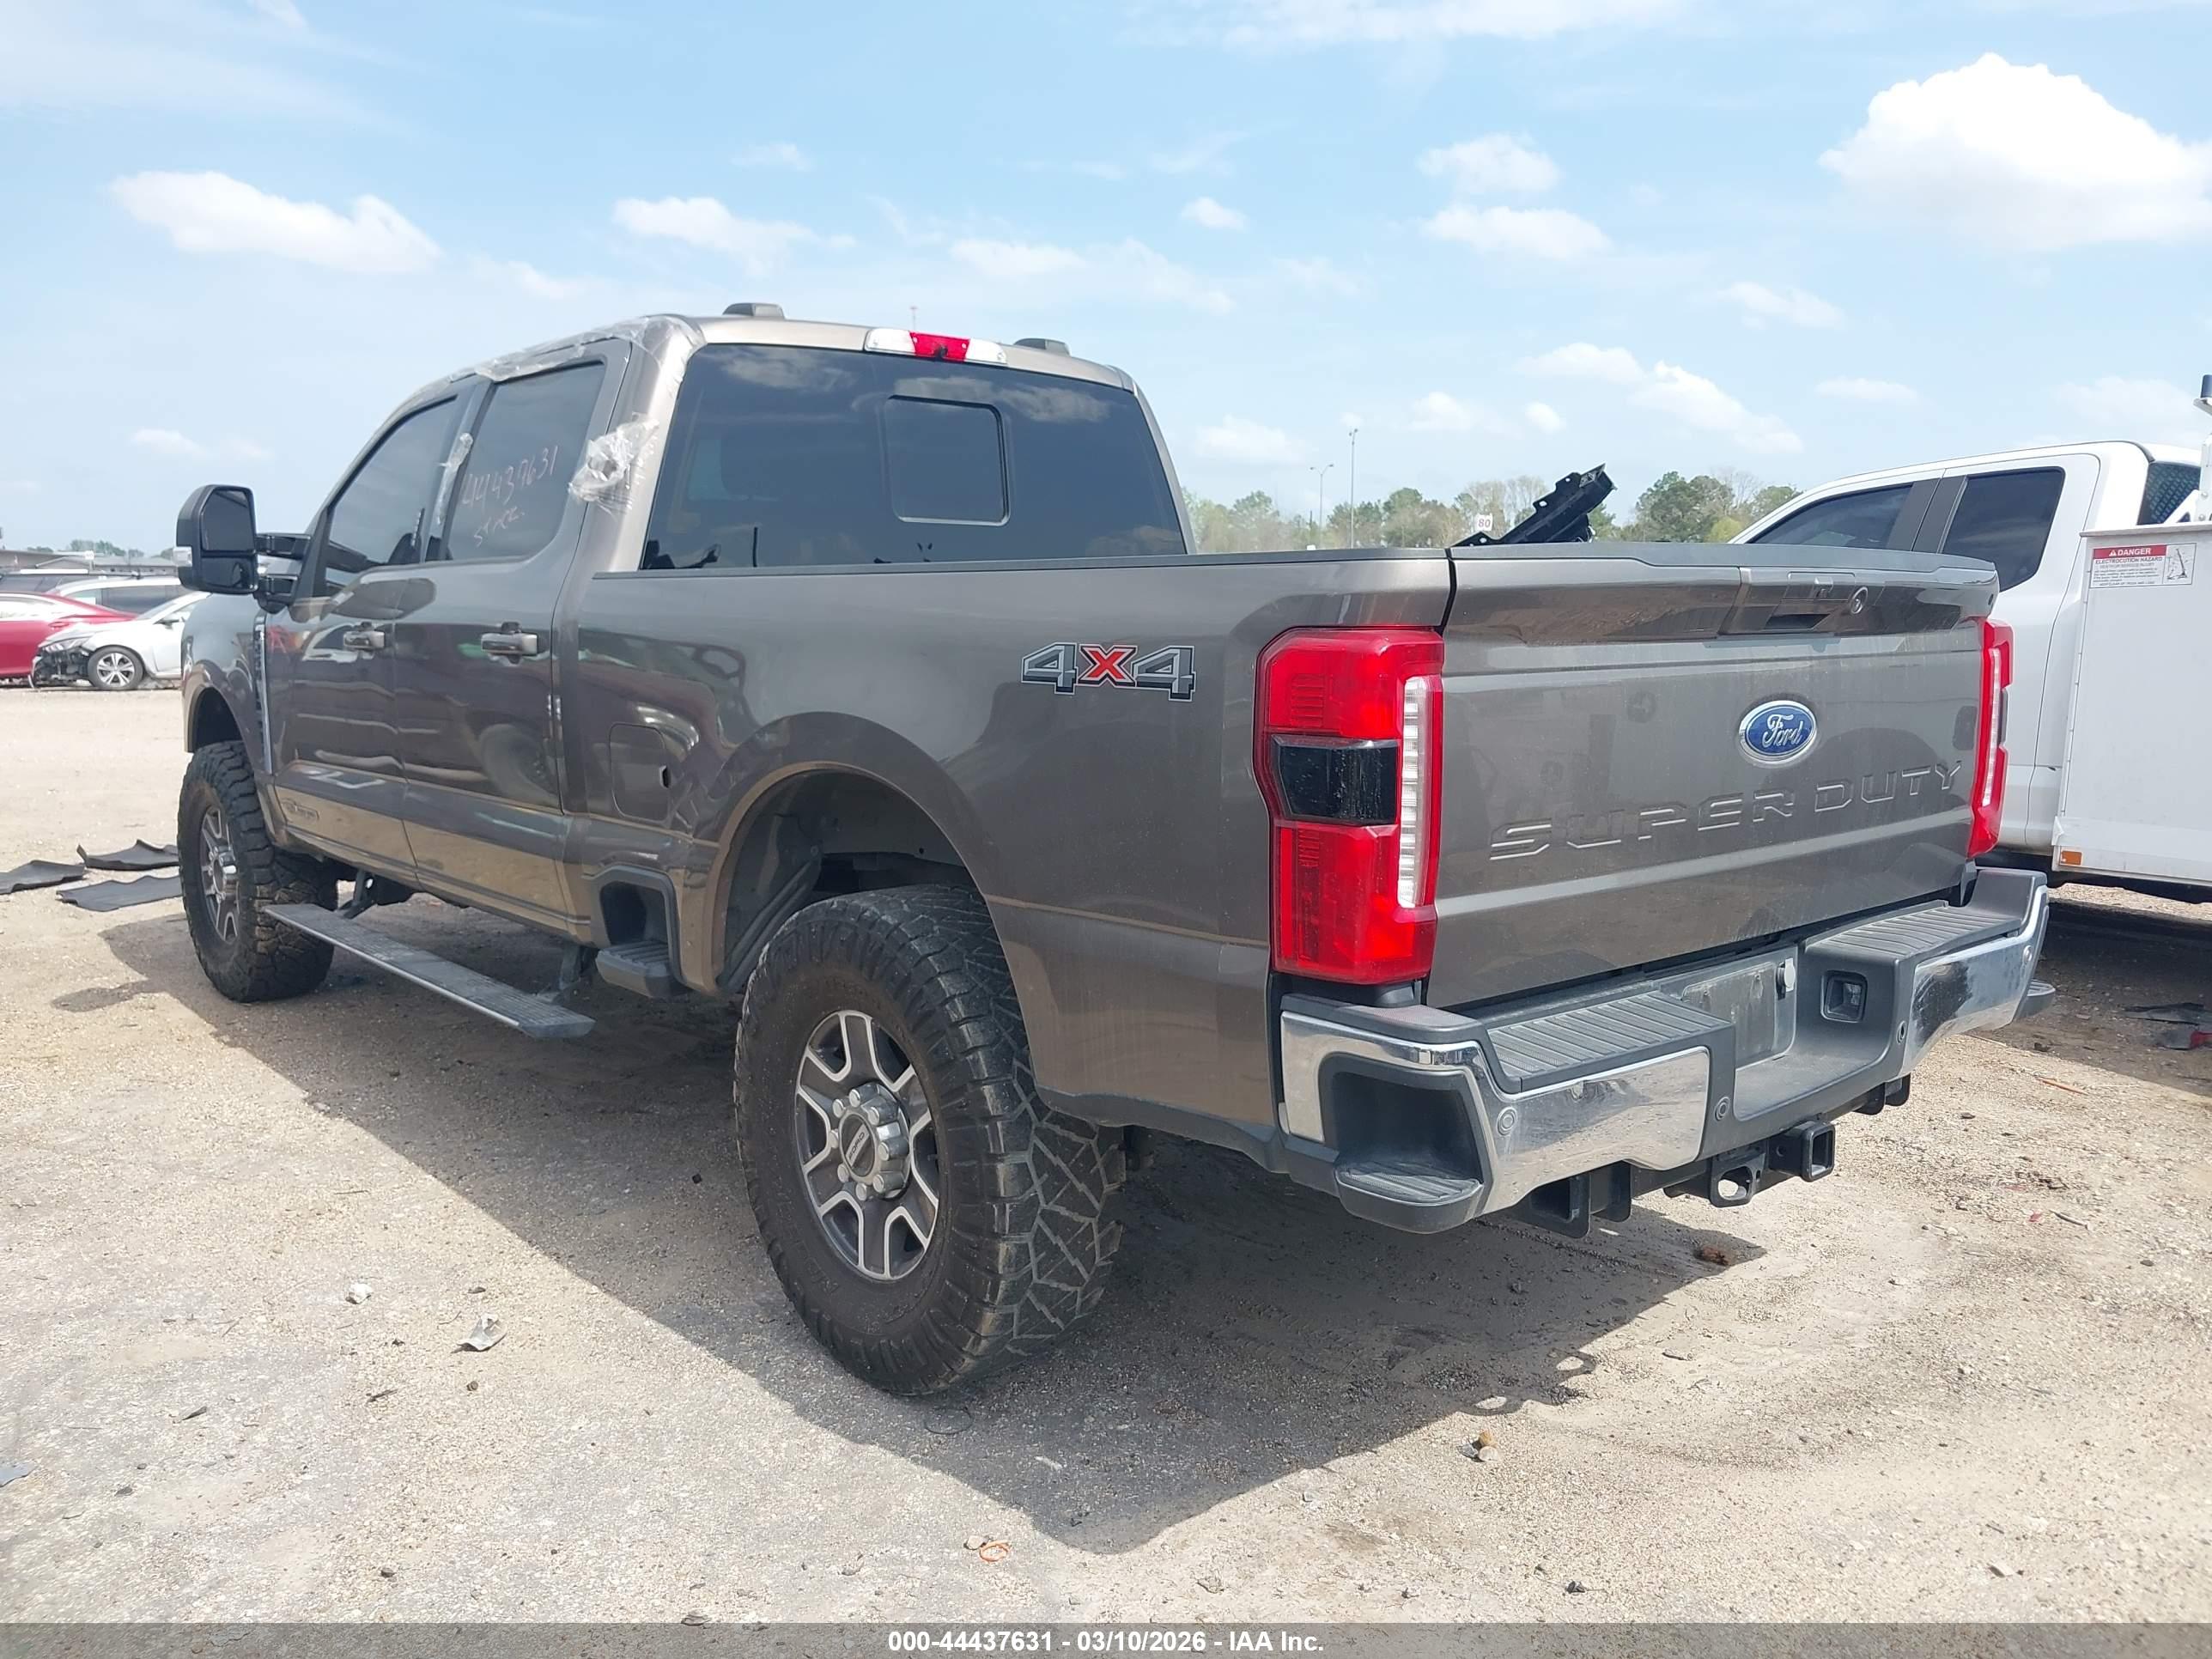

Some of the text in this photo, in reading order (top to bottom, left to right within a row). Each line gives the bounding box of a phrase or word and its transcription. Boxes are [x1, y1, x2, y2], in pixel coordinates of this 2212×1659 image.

[1478, 518, 1491, 528] 80
[1762, 714, 1804, 748] Ford
[1490, 760, 1962, 860] SUPER DUTY
[849, 1132, 865, 1160] FORD
